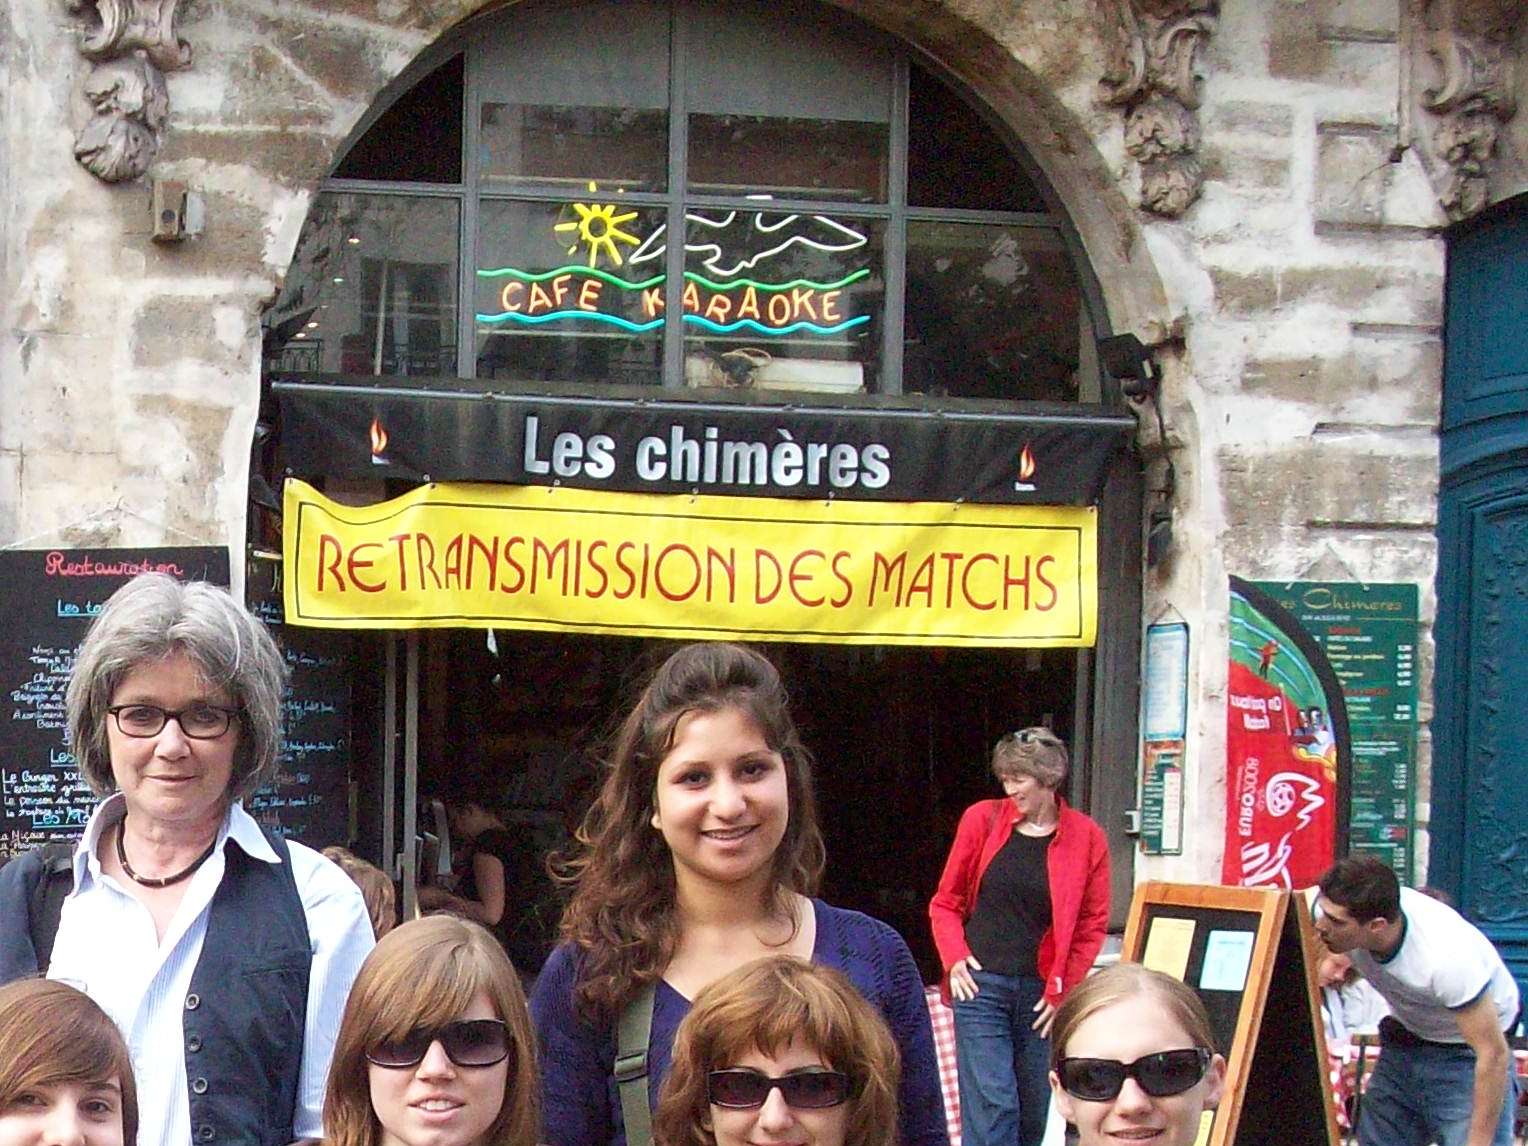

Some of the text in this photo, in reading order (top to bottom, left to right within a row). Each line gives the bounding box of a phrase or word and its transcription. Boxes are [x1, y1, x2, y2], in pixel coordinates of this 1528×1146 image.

[502, 275, 842, 326] CAFE KARAOKE
[523, 416, 891, 490] Les chimères
[316, 532, 1059, 612] RETRANSMISSION DES MATCHS
